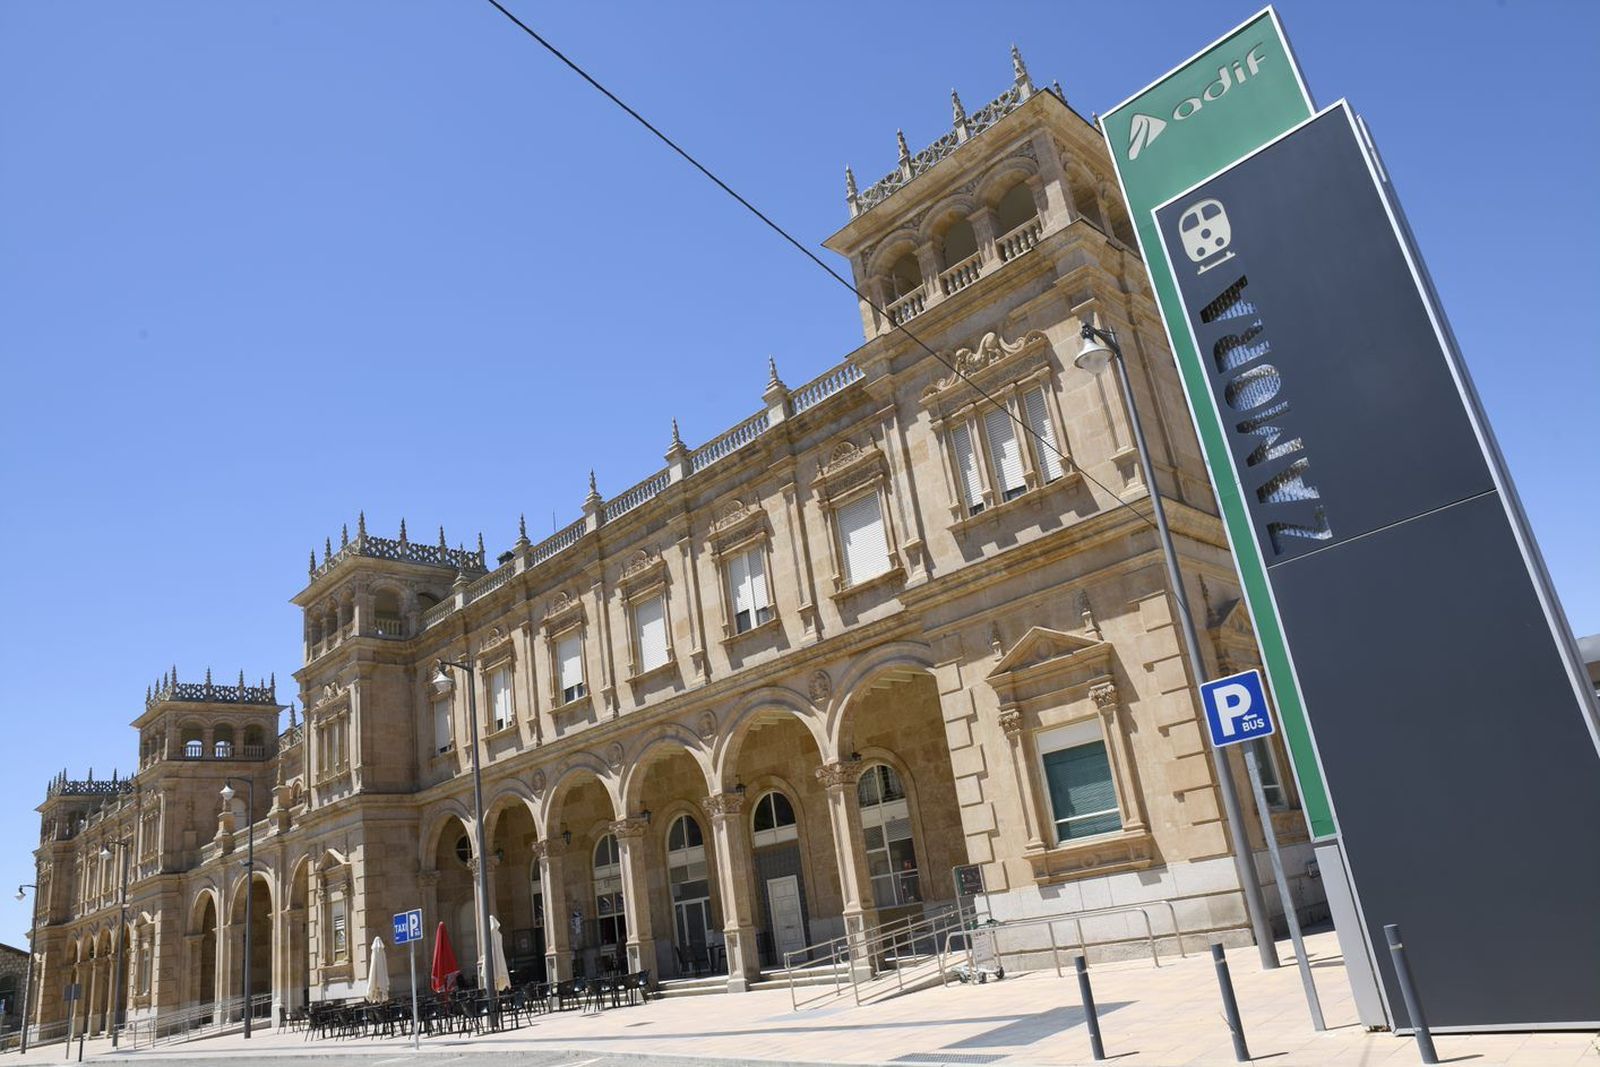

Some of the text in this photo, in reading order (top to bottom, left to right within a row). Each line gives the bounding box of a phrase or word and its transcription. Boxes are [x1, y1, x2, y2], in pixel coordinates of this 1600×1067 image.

[1172, 42, 1266, 121] adif
[1200, 274, 1333, 556] ZAMORA
[1212, 683, 1252, 737] P
[1241, 718, 1265, 732] BUS
[409, 914, 419, 937] P
